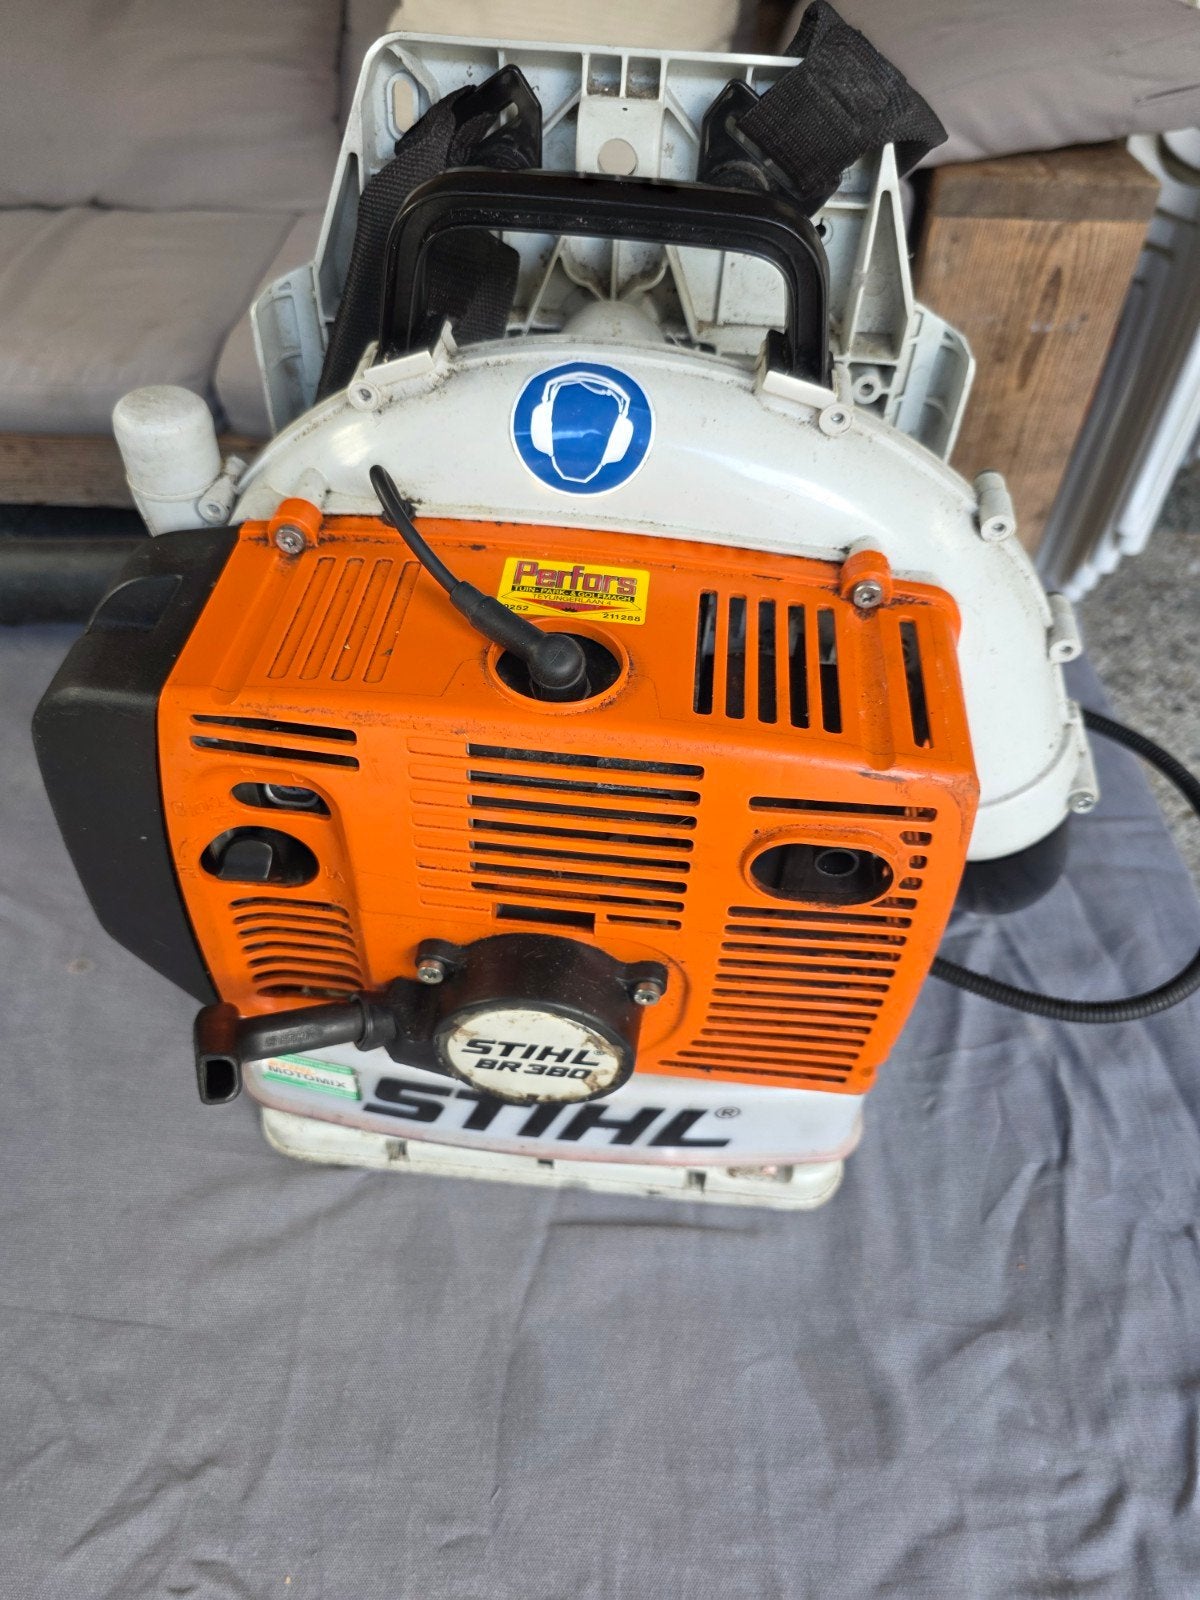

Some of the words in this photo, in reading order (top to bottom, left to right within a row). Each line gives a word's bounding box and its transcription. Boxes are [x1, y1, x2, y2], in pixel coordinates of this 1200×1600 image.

[513, 561, 638, 596] Perfors
[602, 612, 641, 622] 211288
[461, 1038, 600, 1066] STIHL
[268, 1065, 347, 1088] MOTOMIX
[475, 1058, 522, 1072] BR
[524, 1064, 593, 1080] 380
[363, 1076, 732, 1148] STIHL
